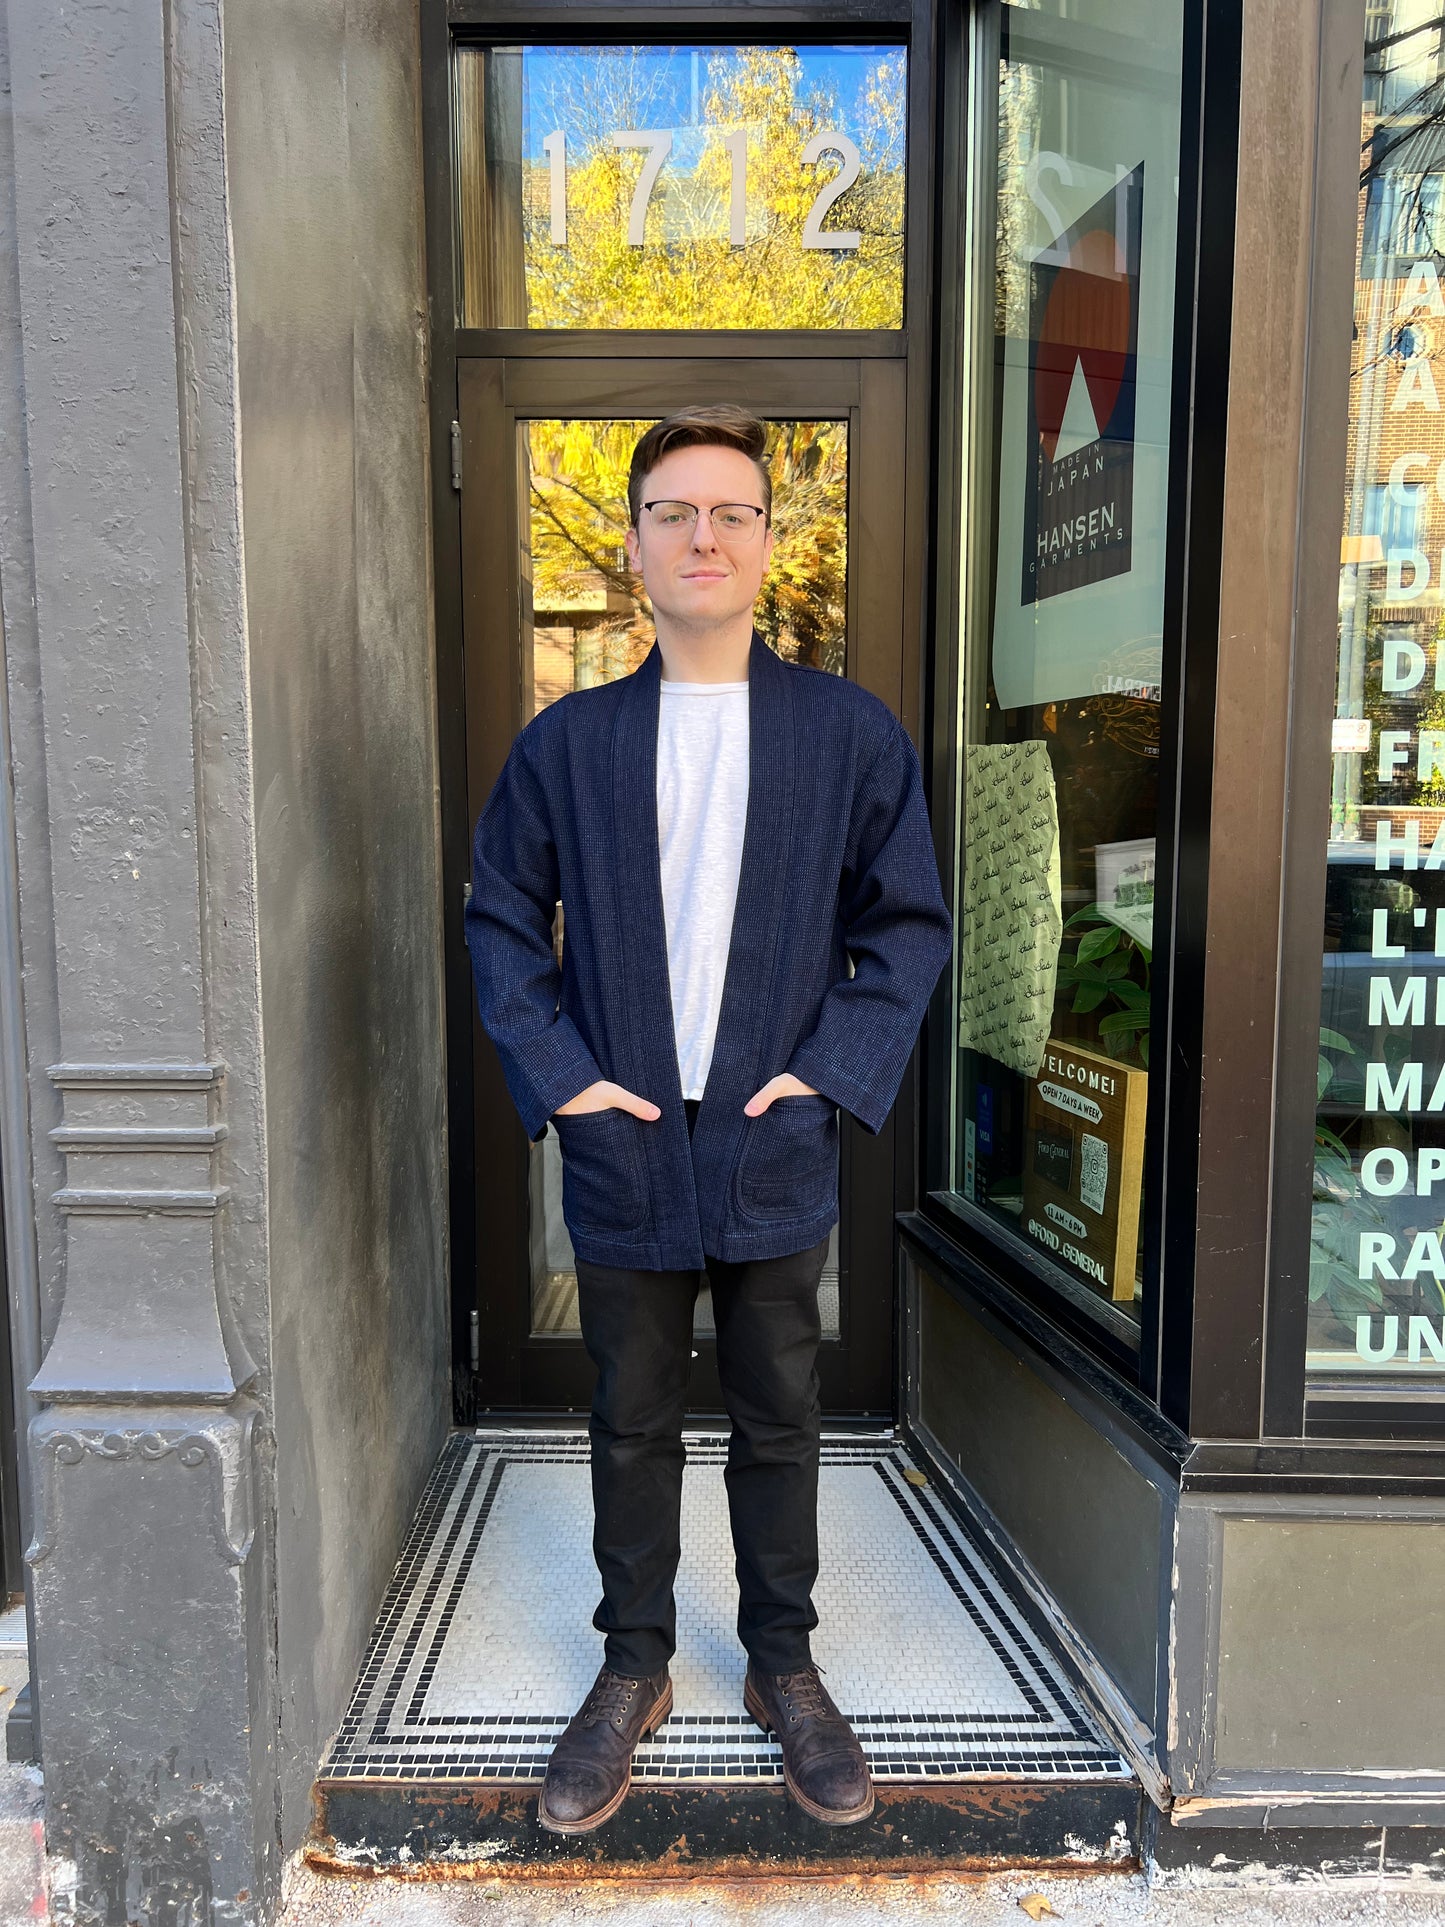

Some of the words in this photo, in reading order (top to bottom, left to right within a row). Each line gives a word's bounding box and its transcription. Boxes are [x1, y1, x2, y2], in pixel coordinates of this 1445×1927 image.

[543, 130, 860, 249] 1712
[1047, 455, 1104, 497] JAPAN
[1053, 452, 1080, 475] MADE
[1088, 443, 1099, 457] IN
[1389, 453, 1445, 507] C
[1029, 527, 1123, 573] GARMENTS
[1037, 502, 1115, 557] HANSEN
[1386, 548, 1445, 600] D
[1382, 640, 1445, 692] D
[1372, 908, 1445, 958] L'
[1368, 976, 1445, 1026] M
[1042, 1084, 1058, 1099] OPEN
[1062, 1094, 1077, 1109] DAYS
[1077, 1102, 1083, 1112] A
[1083, 1103, 1100, 1120] WEEK
[1047, 1206, 1053, 1218] 11
[1055, 1210, 1065, 1224] AM
[1068, 1220, 1073, 1229] 6
[1073, 1221, 1083, 1236] PM
[1028, 1218, 1108, 1286] @FORD_GENERAL
[1358, 1231, 1445, 1280] RA
